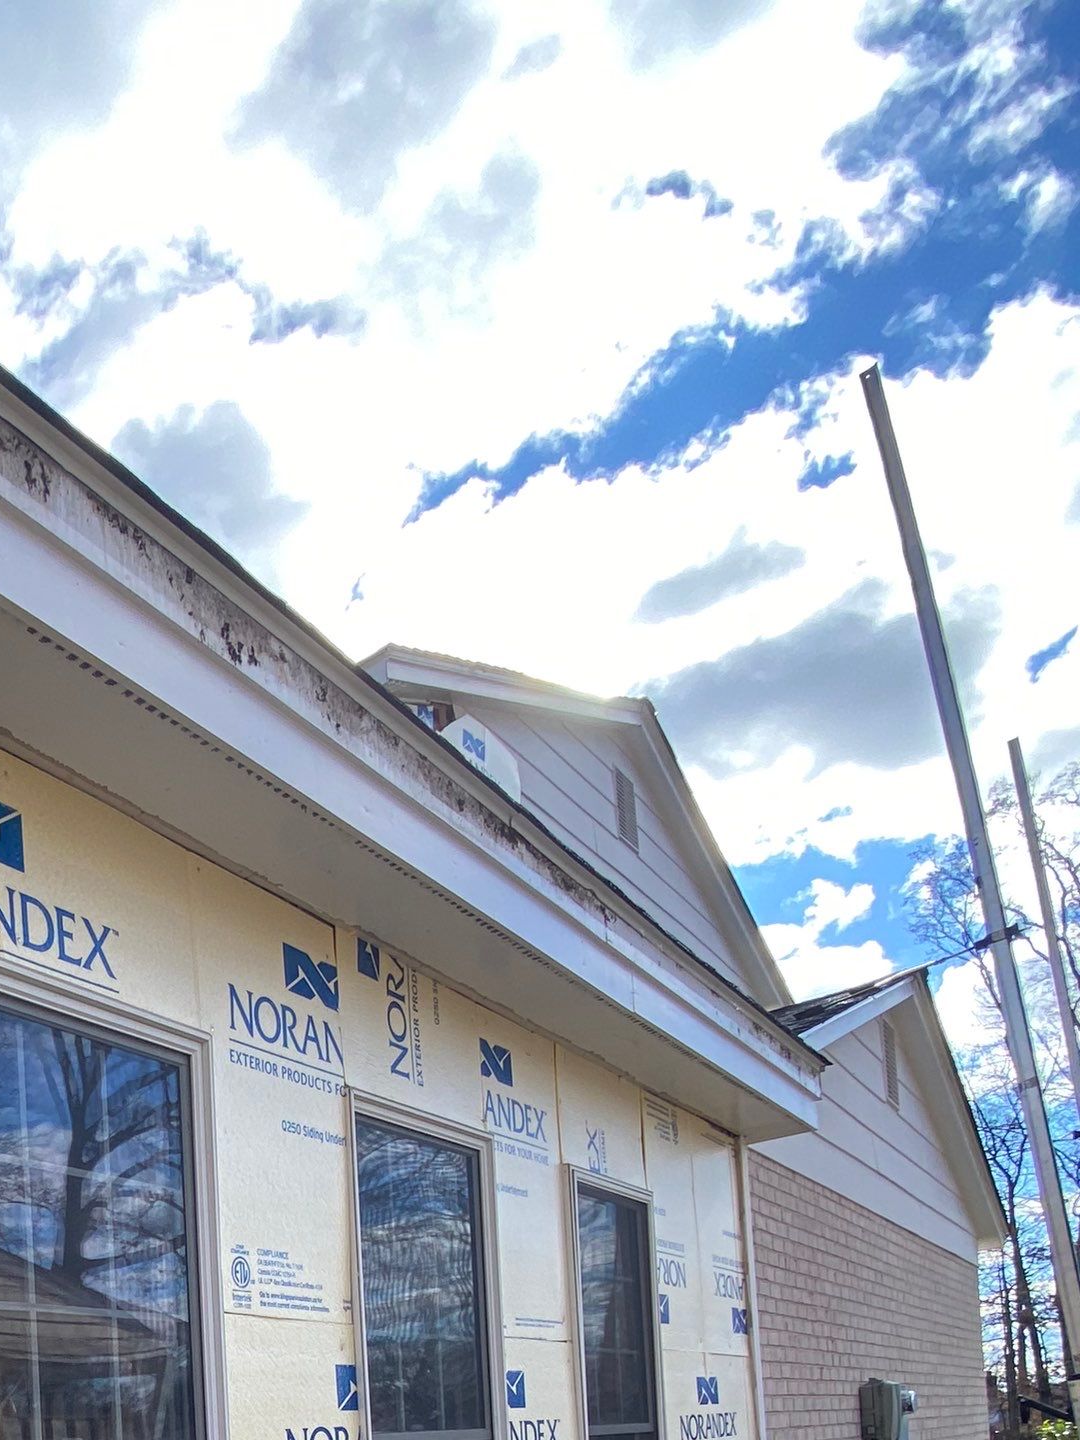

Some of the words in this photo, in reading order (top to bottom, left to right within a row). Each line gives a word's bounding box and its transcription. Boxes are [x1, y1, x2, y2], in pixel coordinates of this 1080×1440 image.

[229, 1049, 279, 1079] EXTERIOR
[281, 1066, 332, 1095] PRODUCTS
[412, 1018, 424, 1087] EXTERIOR
[281, 1119, 302, 1136] Q250
[302, 1126, 324, 1143] Siding
